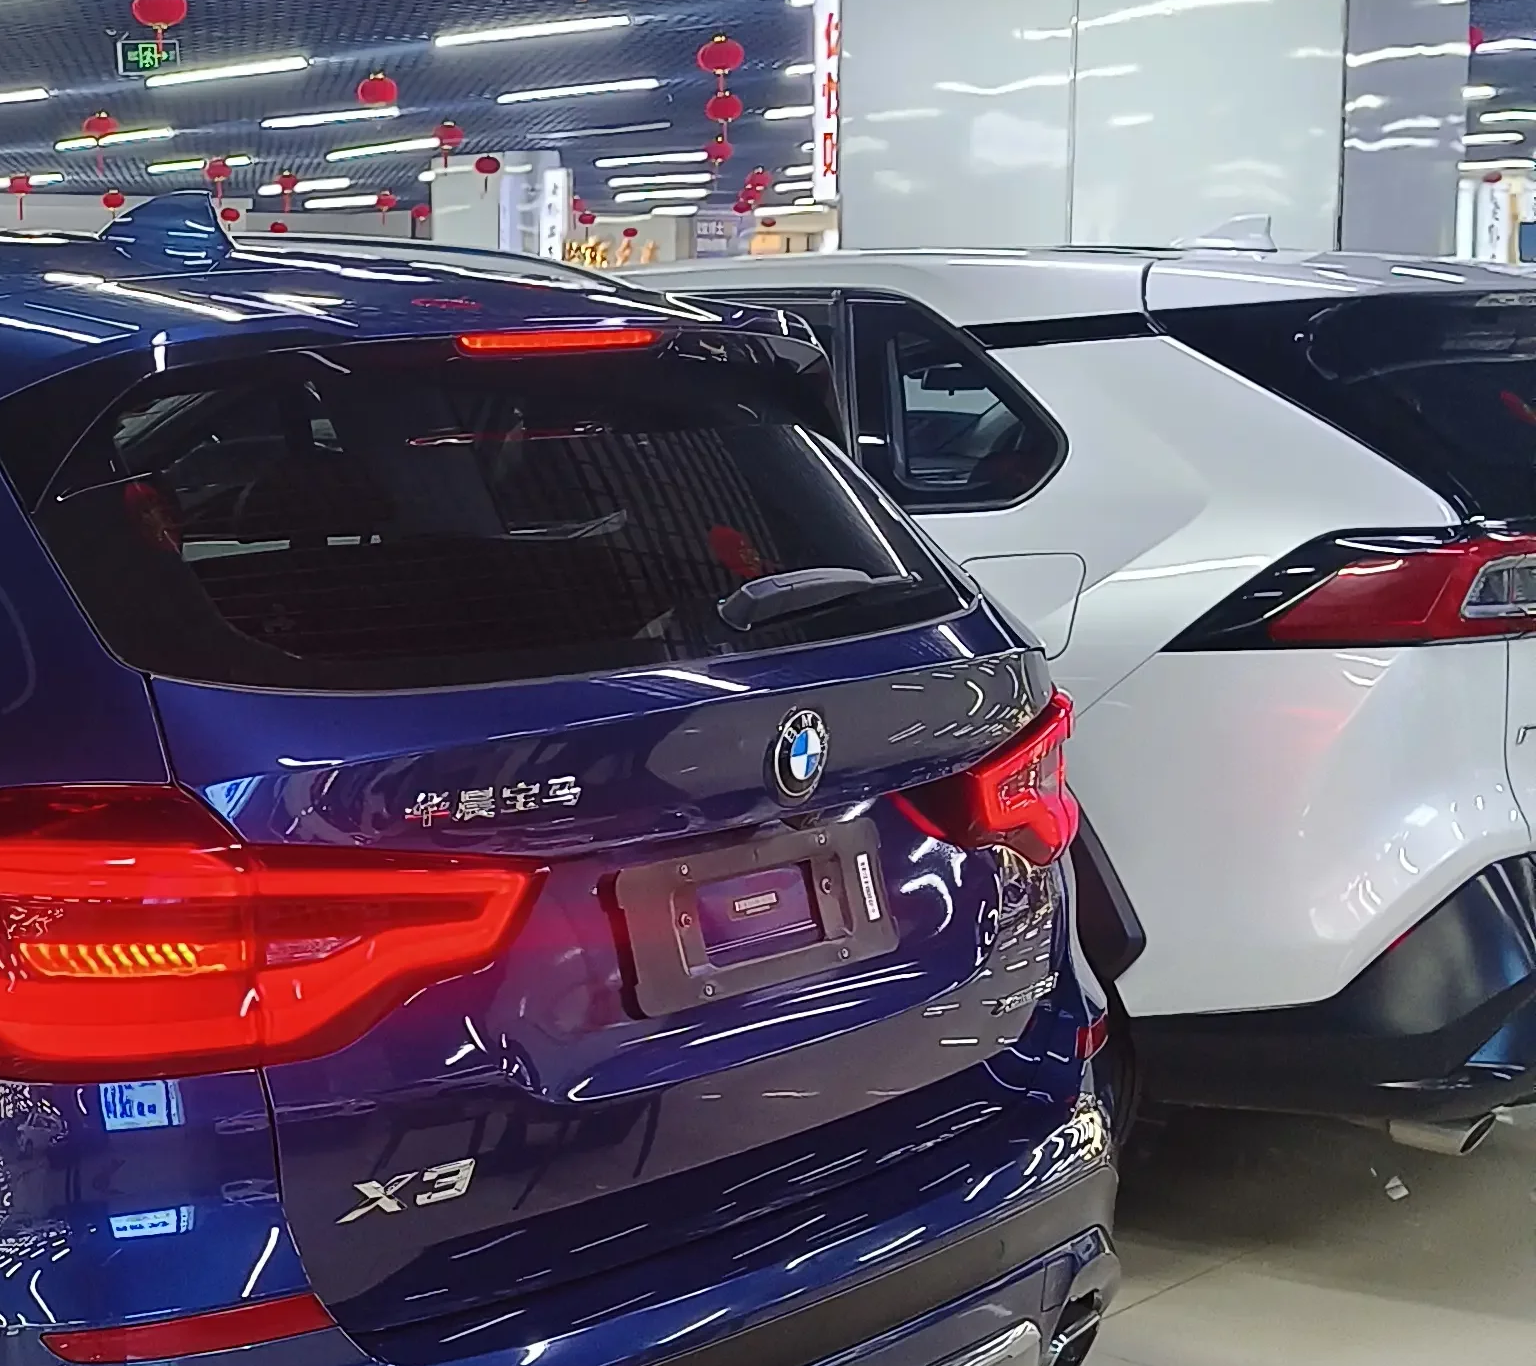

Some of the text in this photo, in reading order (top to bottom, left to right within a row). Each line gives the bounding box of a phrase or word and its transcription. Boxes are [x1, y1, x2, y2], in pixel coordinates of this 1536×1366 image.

[405, 776, 582, 828] 华晨宝马
[335, 1158, 476, 1224] X3
